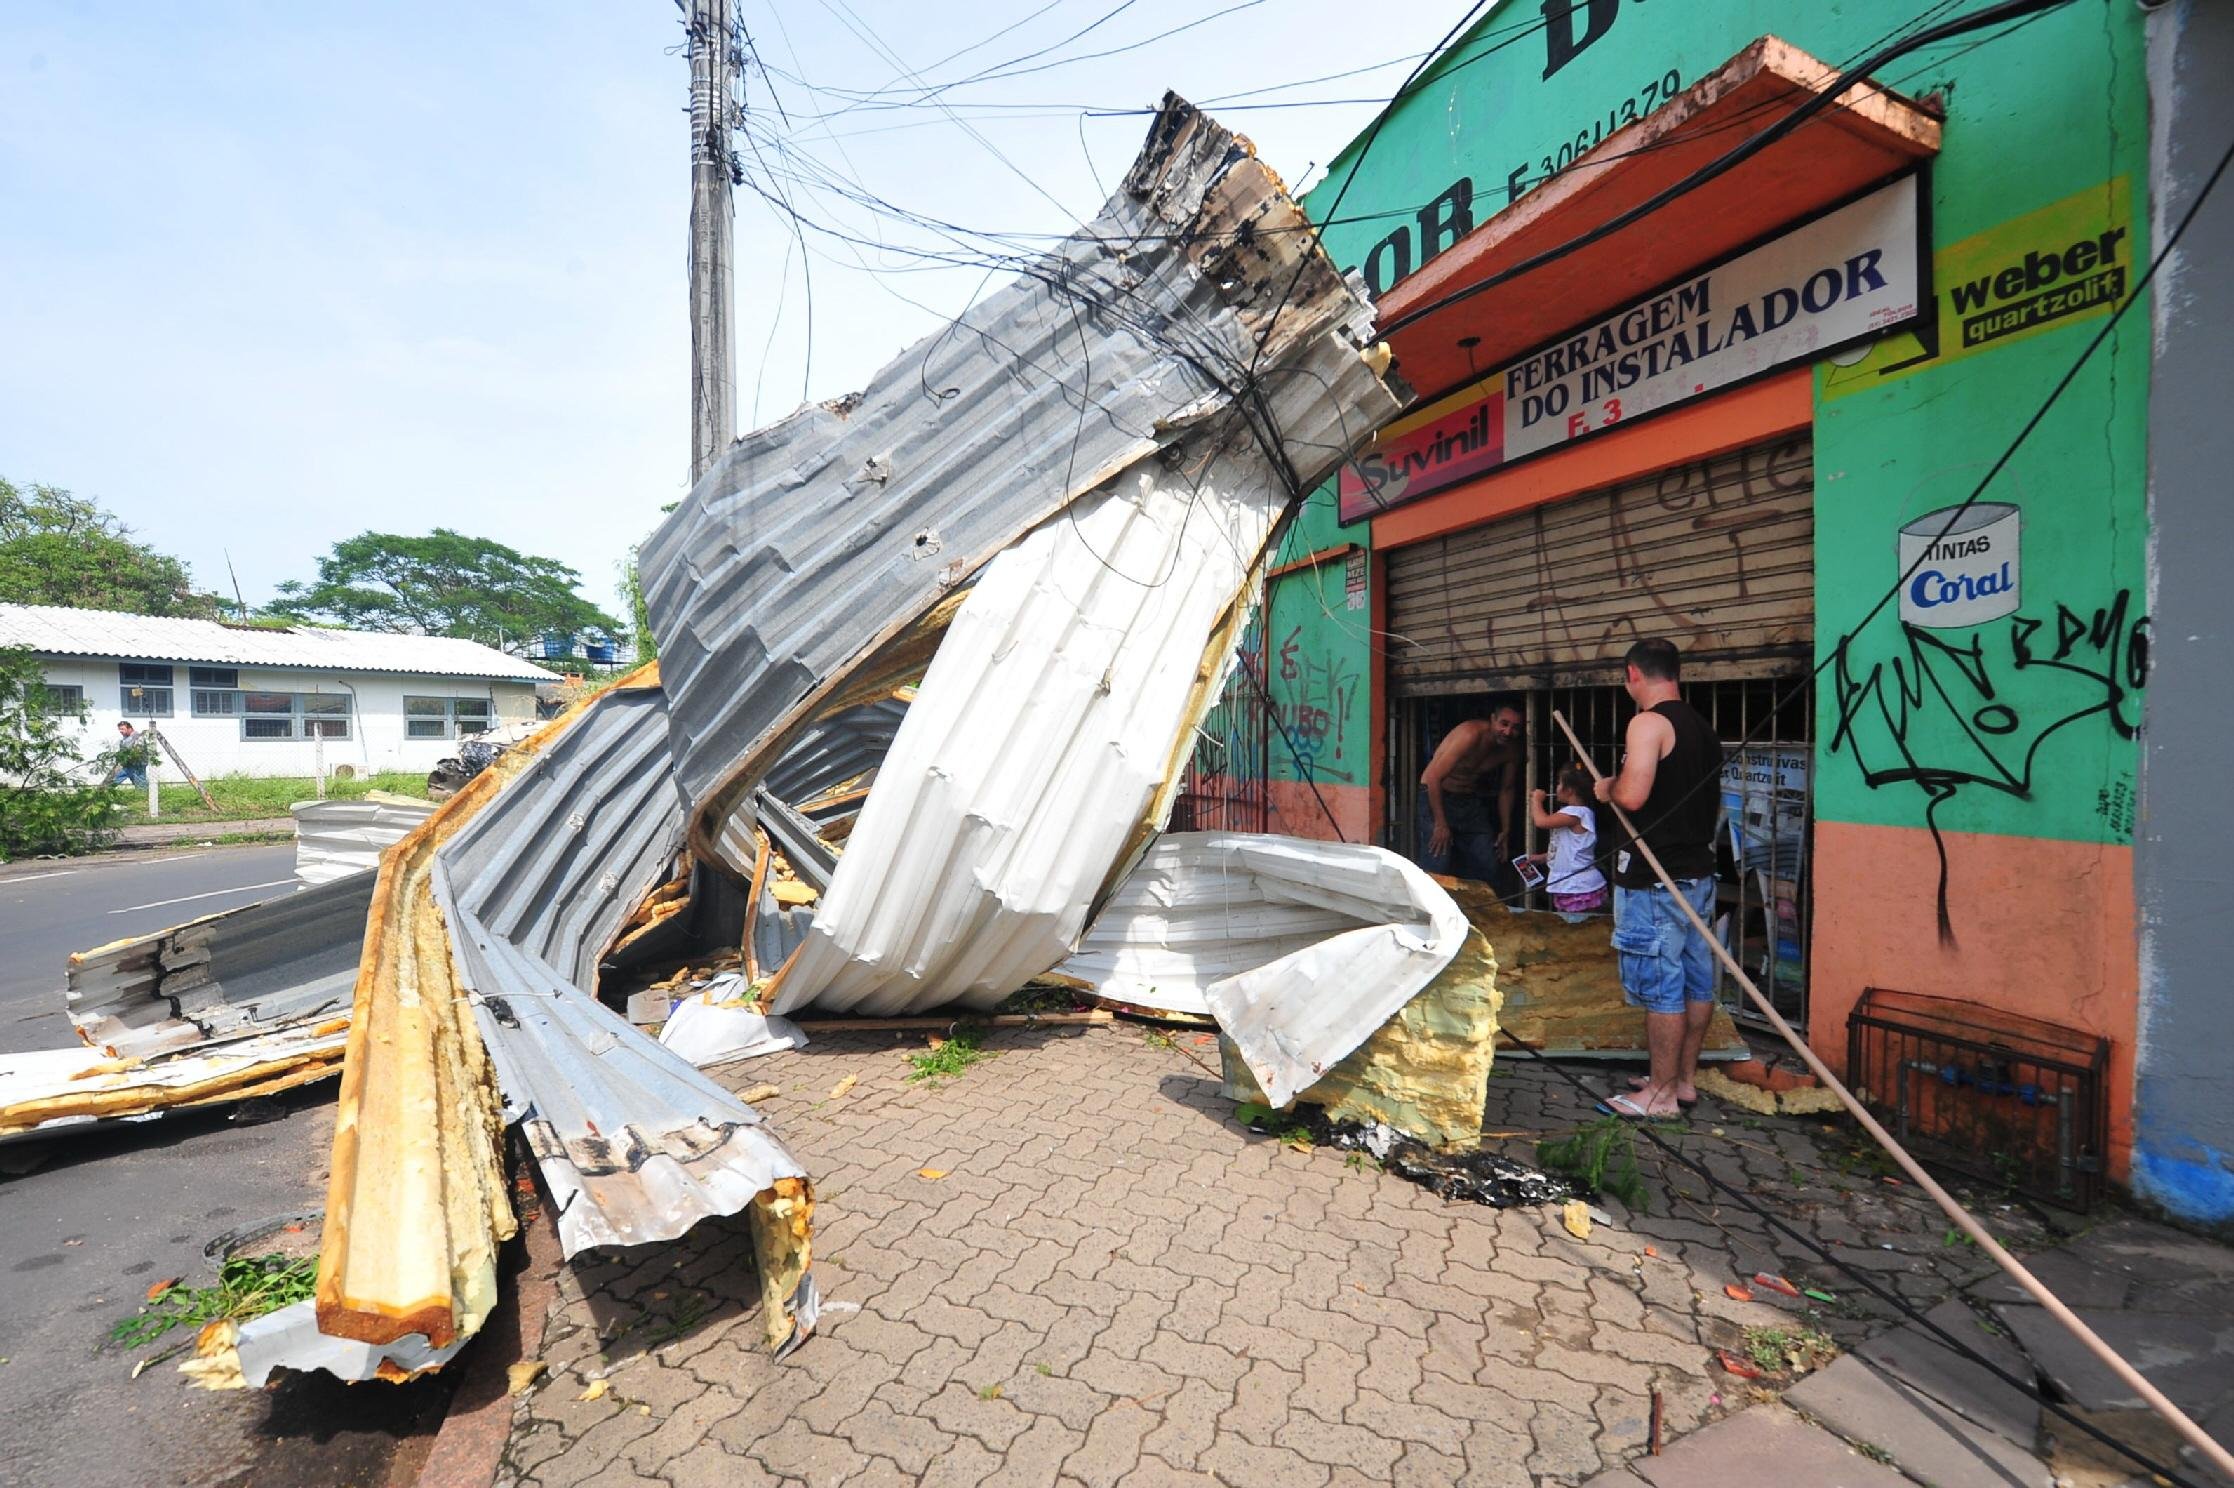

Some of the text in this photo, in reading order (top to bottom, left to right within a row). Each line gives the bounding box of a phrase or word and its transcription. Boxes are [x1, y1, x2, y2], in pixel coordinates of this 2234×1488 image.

[1541, 0, 1647, 82] D
[1341, 176, 1473, 303] OR
[1951, 227, 2125, 316] weber
[1507, 276, 1711, 400] FERRAGEM
[1522, 383, 1570, 429] DO
[1581, 248, 1889, 405] INSTALADOR
[1968, 272, 2119, 341] quartzolit
[1359, 404, 1488, 495] Suvinil
[1910, 560, 2015, 609] Coral
[1926, 535, 1991, 561] TINTAS
